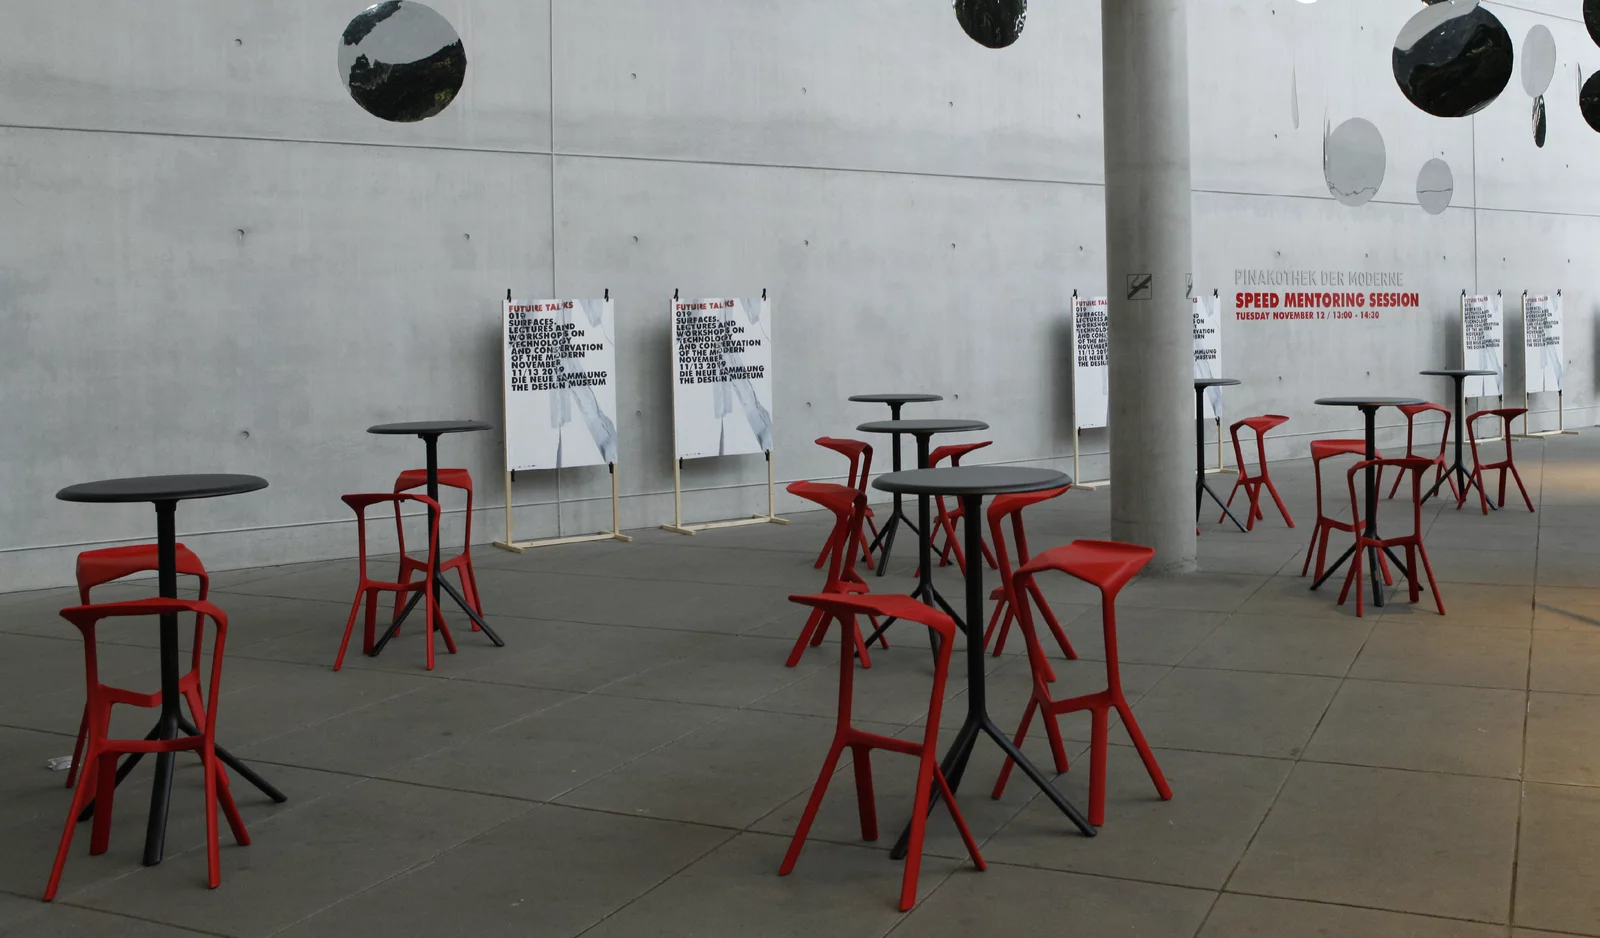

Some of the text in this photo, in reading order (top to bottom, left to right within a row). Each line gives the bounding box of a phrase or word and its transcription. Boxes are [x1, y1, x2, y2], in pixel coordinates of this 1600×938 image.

[1234, 269, 1403, 287] PINAKOTHEK DER MODERNE
[709, 300, 734, 309] TALKS
[1235, 292, 1419, 308] SPEED MENTORING SESSION
[509, 302, 574, 313] FUTURE TALKS
[1236, 311, 1270, 320] TUESDAY
[1272, 311, 1314, 320] NOVEMBER
[1316, 311, 1325, 319] 12
[1333, 311, 1353, 319] 13:00
[1360, 311, 1379, 319] 14:30
[509, 324, 575, 334] LECTURES AND
[676, 320, 736, 331] LECTURES AND
[509, 331, 569, 342] WORKSHOPS
[676, 328, 730, 337] WORKSHOPS
[509, 337, 572, 348] TECHNOLOGY
[511, 347, 531, 355] AND
[512, 354, 525, 362] OF
[526, 354, 543, 362] THE
[679, 355, 723, 363] NOVEMBER
[511, 359, 561, 369] NOVEMBER
[680, 363, 703, 371] 11/13
[512, 366, 564, 377] 11/13 2019
[696, 369, 716, 377] NEUE
[512, 376, 526, 384] DIE
[530, 375, 554, 383] NEUE
[698, 376, 727, 384] DESIGN
[730, 372, 764, 382] MUSEUM
[512, 378, 606, 392] THE DESIGN MUSEUM
